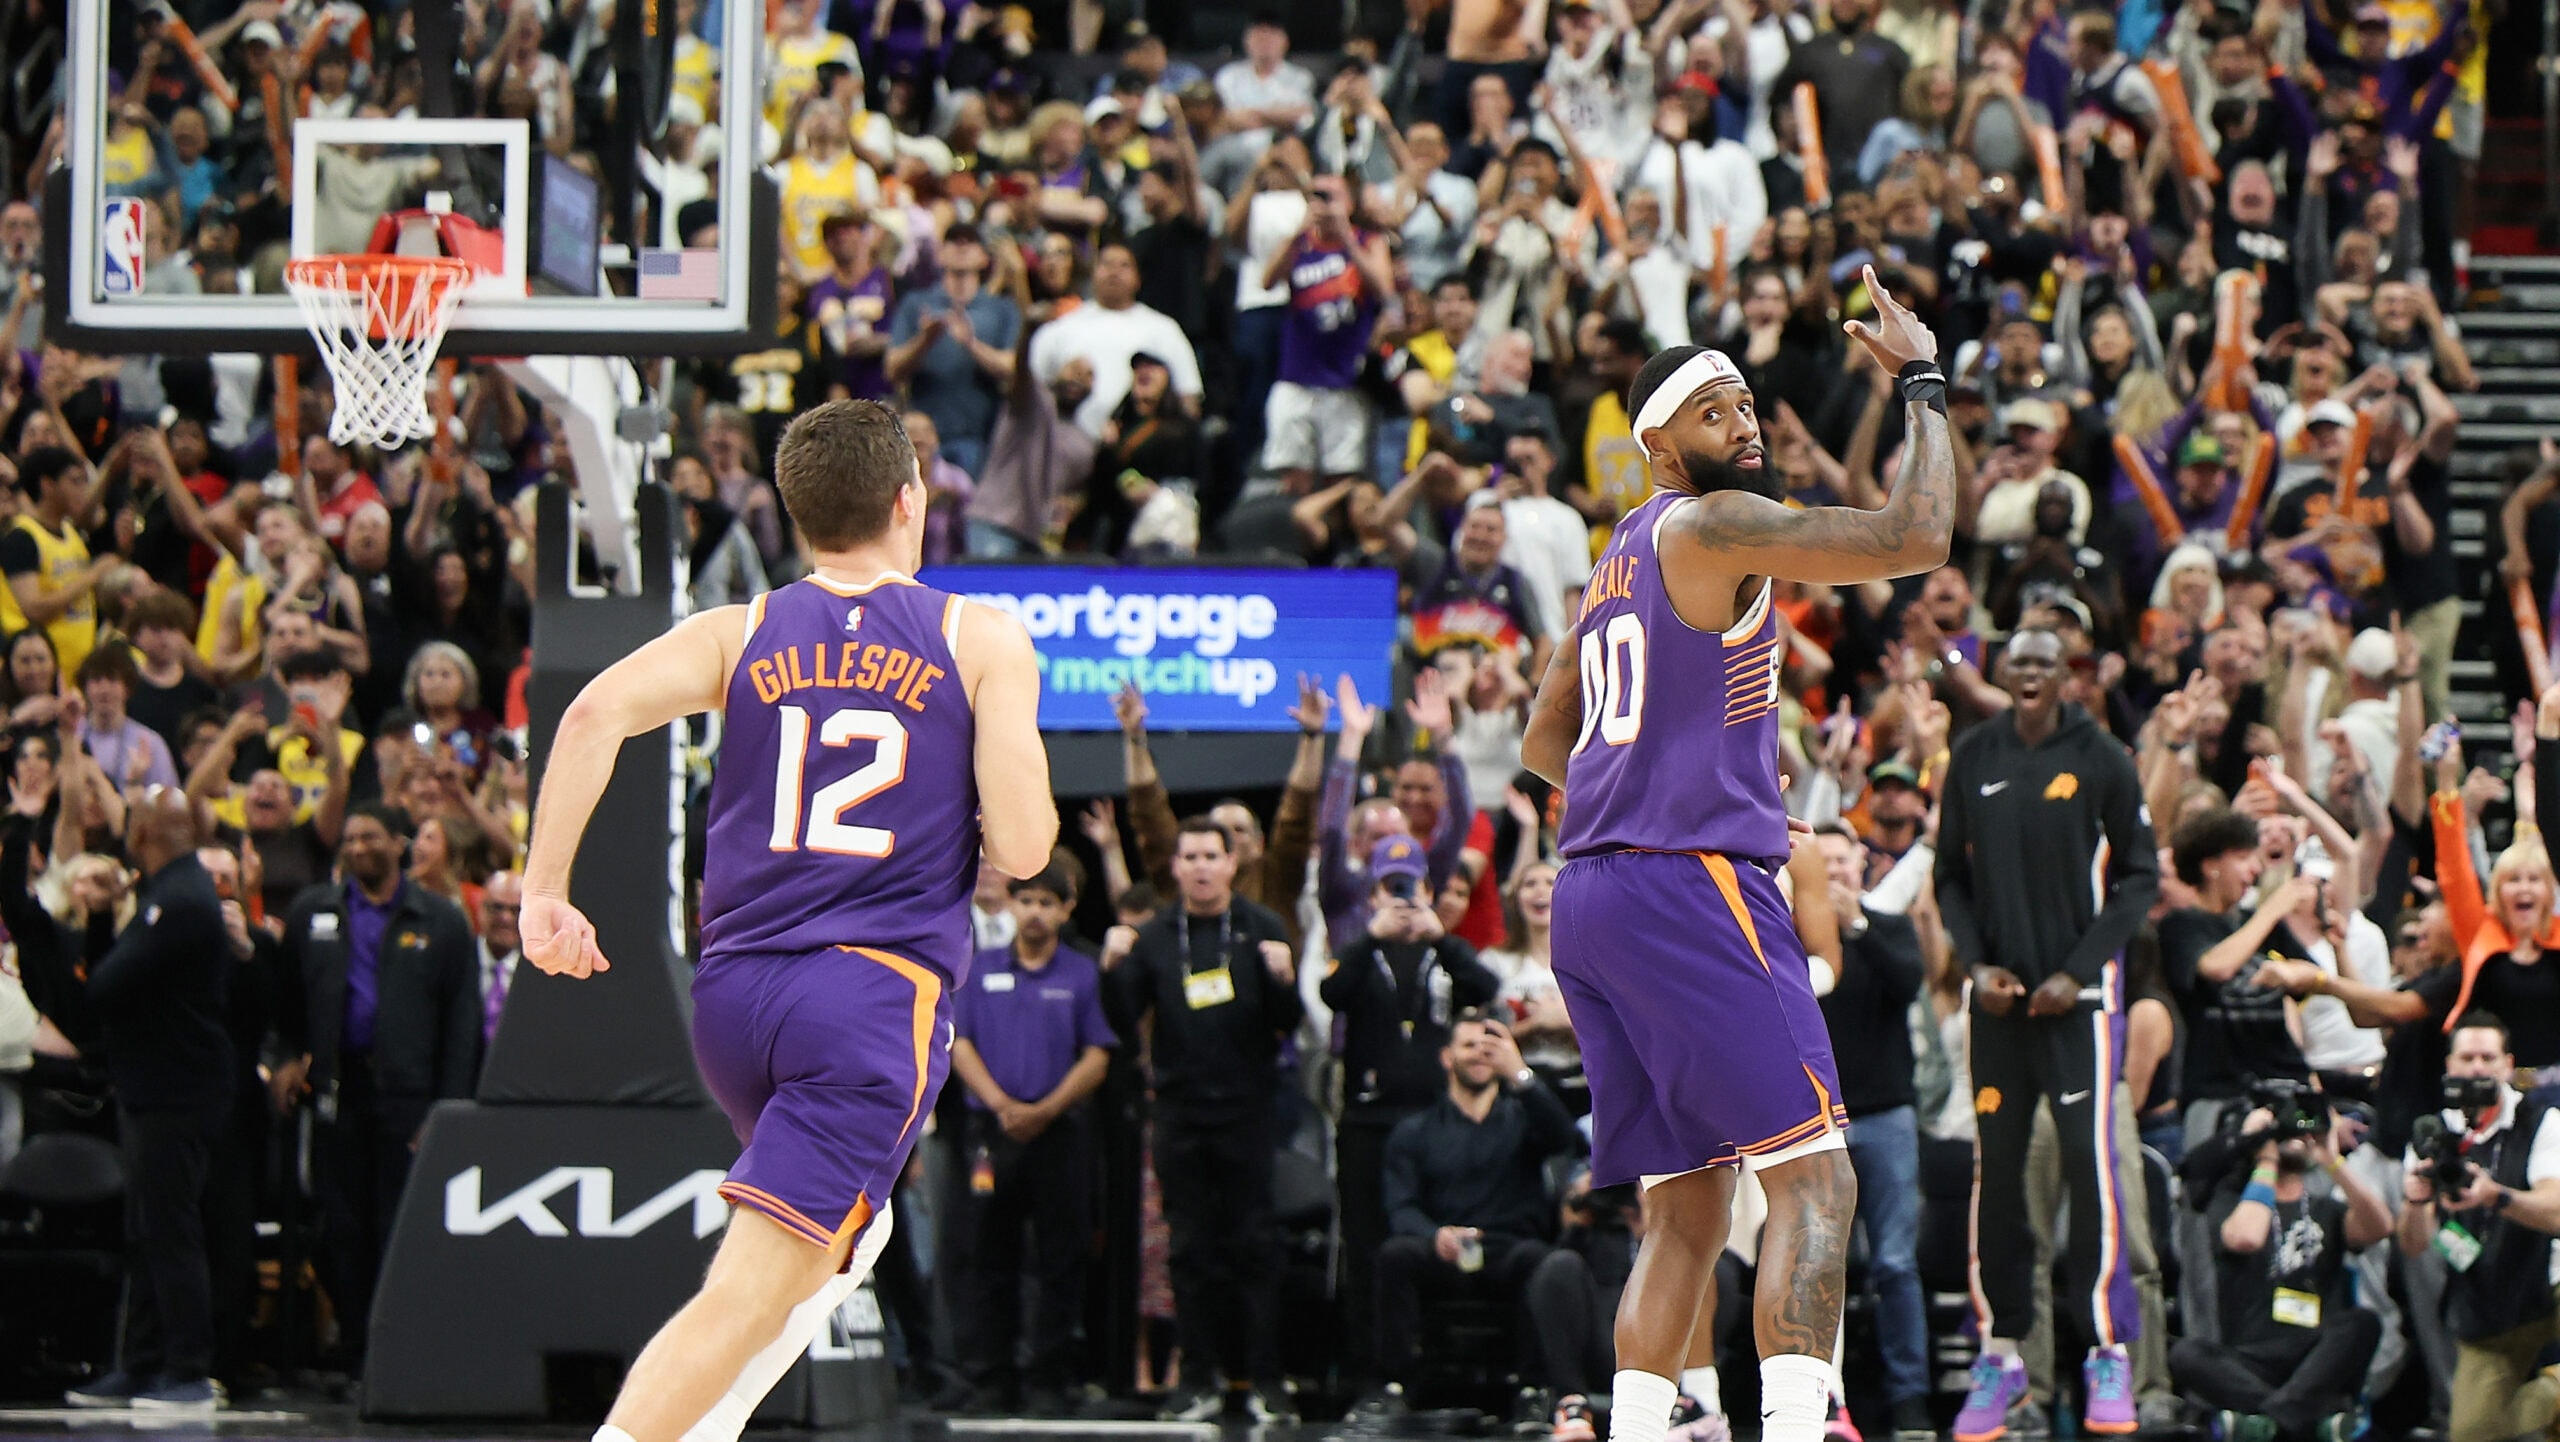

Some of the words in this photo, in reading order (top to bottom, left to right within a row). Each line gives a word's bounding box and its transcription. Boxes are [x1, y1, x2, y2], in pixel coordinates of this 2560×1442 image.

[966, 585, 1278, 657] ortgage
[748, 641, 946, 713] GILLESPIE
[1052, 651, 1278, 708] matchup
[1570, 612, 1647, 759] 00
[768, 704, 909, 859] 12
[445, 1164, 730, 1240] KIA
